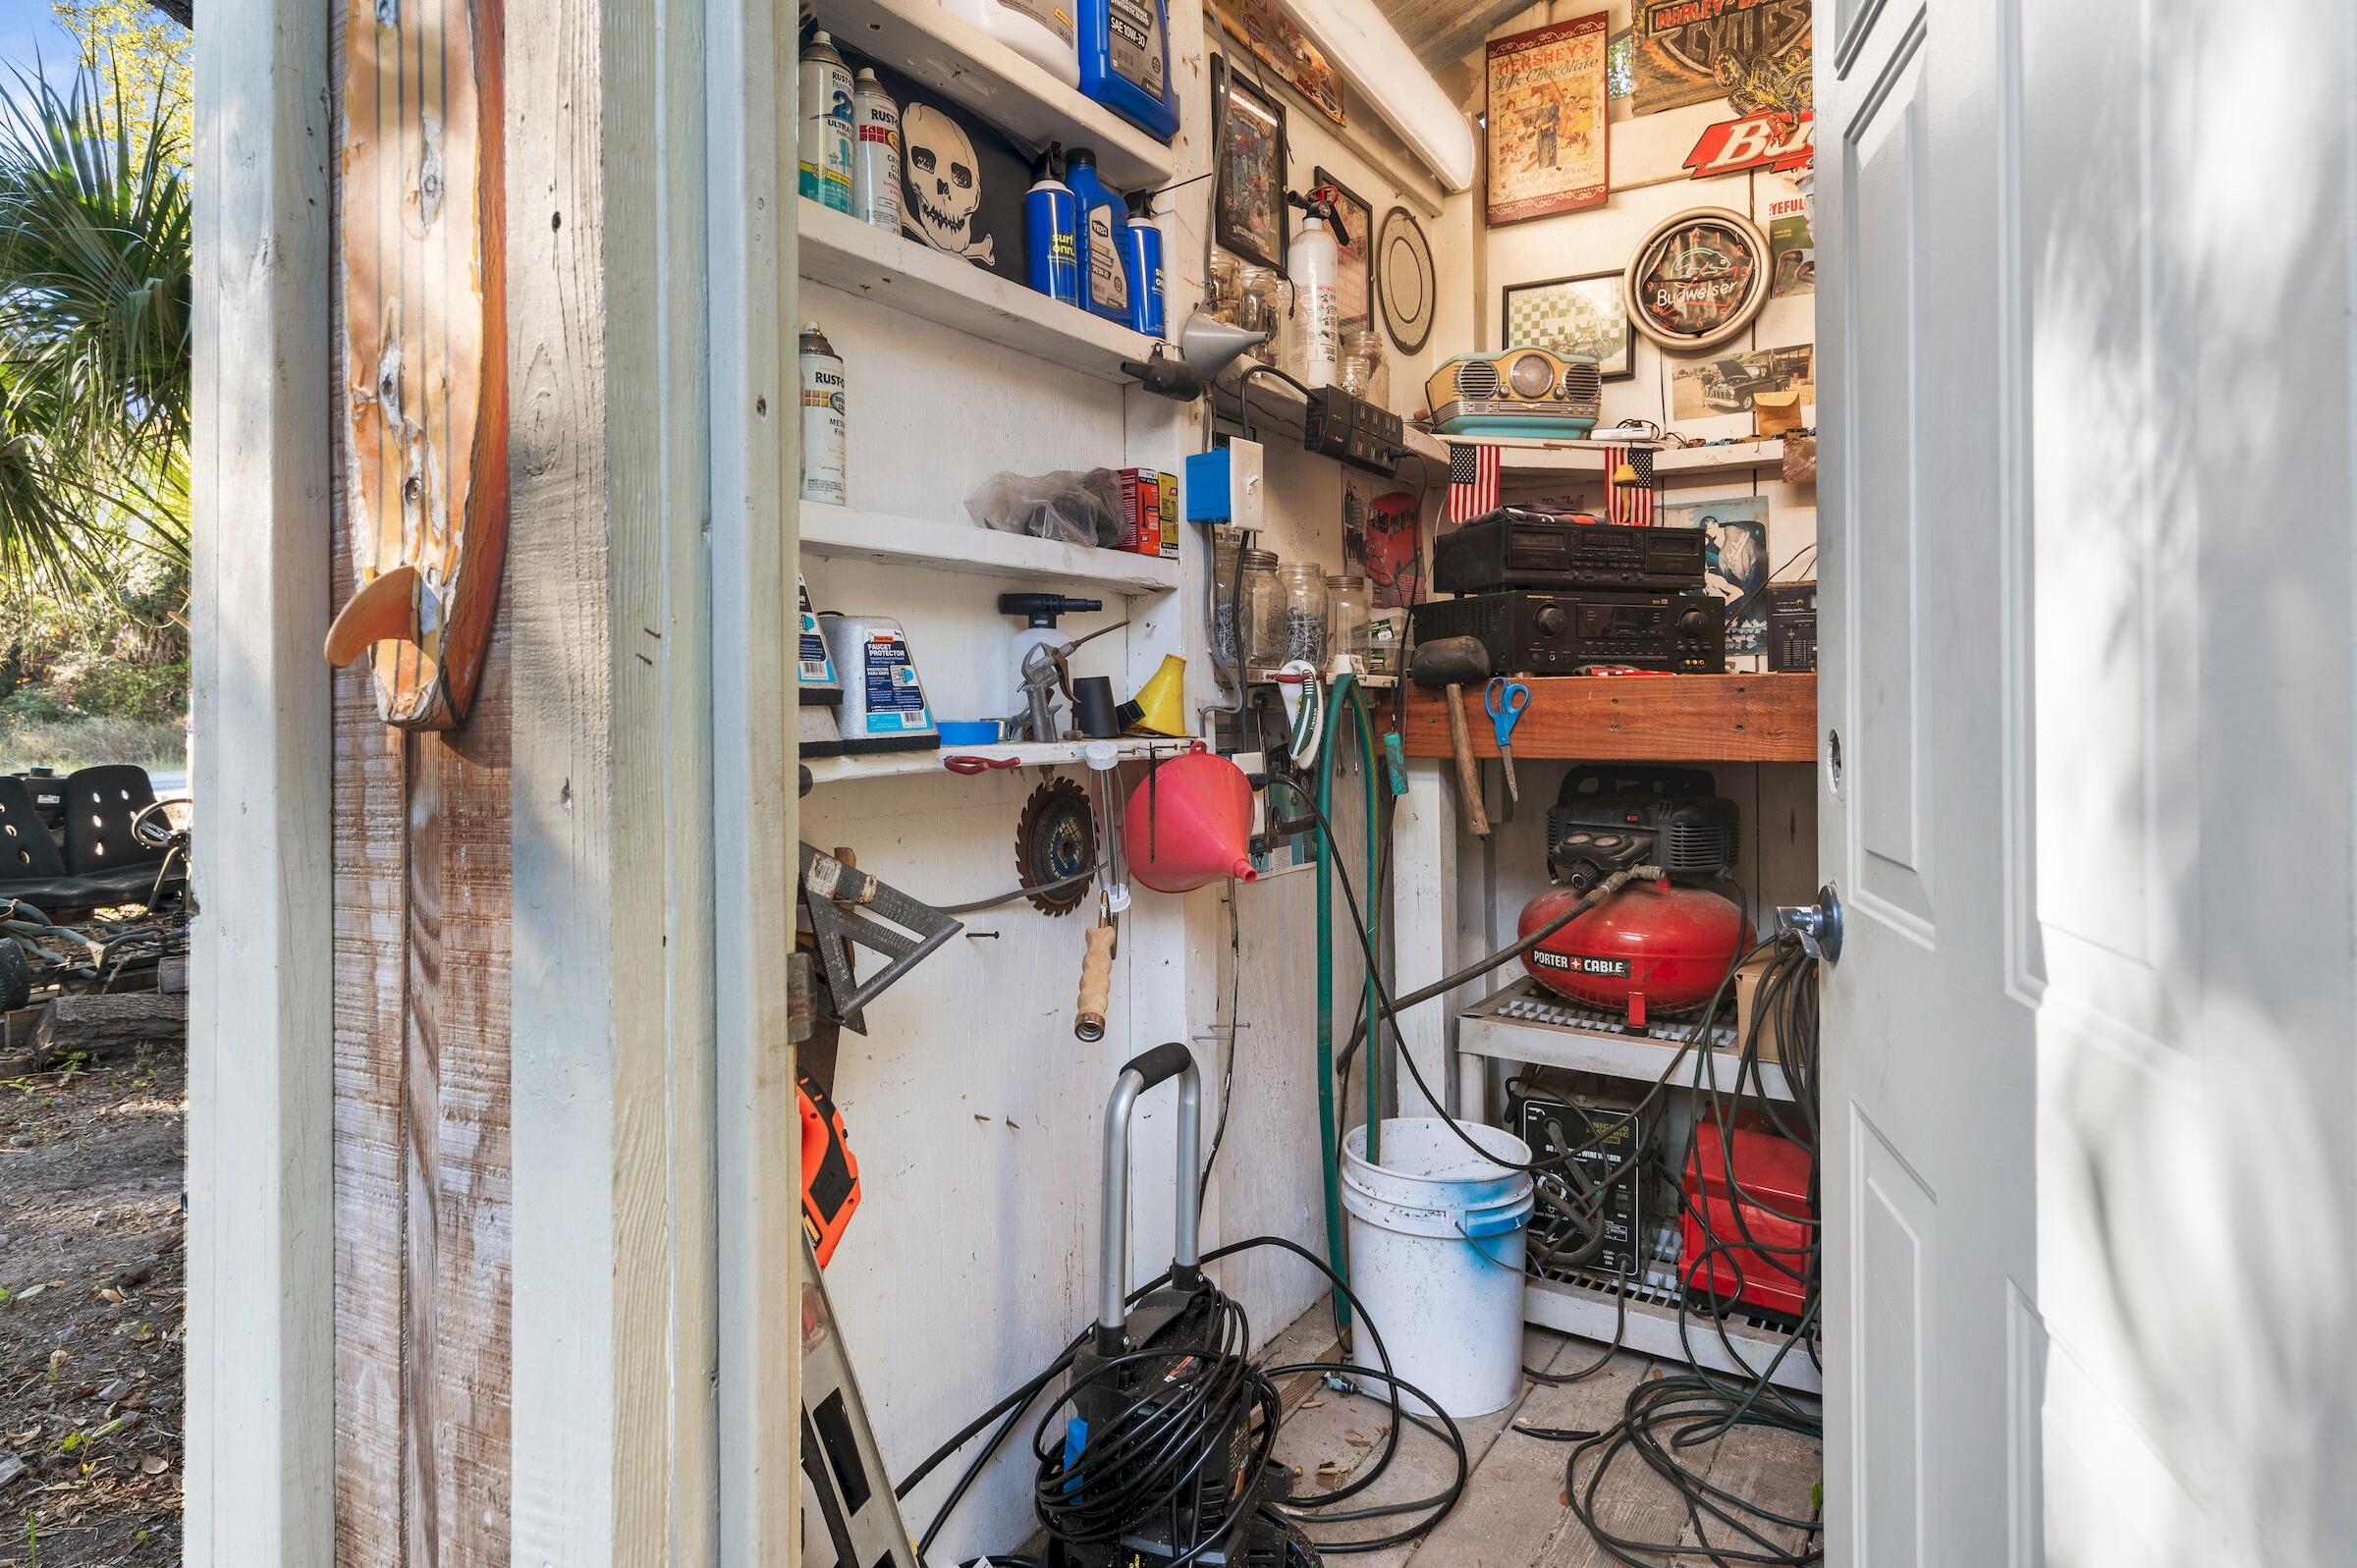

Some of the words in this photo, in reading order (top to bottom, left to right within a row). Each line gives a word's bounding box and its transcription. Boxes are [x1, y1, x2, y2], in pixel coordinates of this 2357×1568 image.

[1111, 16, 1124, 34] SAE
[1124, 24, 1146, 47] 10W-30
[1498, 41, 1594, 77] HERSHEY'S
[1526, 58, 1599, 82] Chocolate
[1706, 119, 1813, 169] Bu
[1656, 281, 1738, 307] Budweiser
[1533, 950, 1568, 969] PORTER
[1582, 1150, 1598, 1160] WIRE
[1598, 1152, 1621, 1162] WLDER
